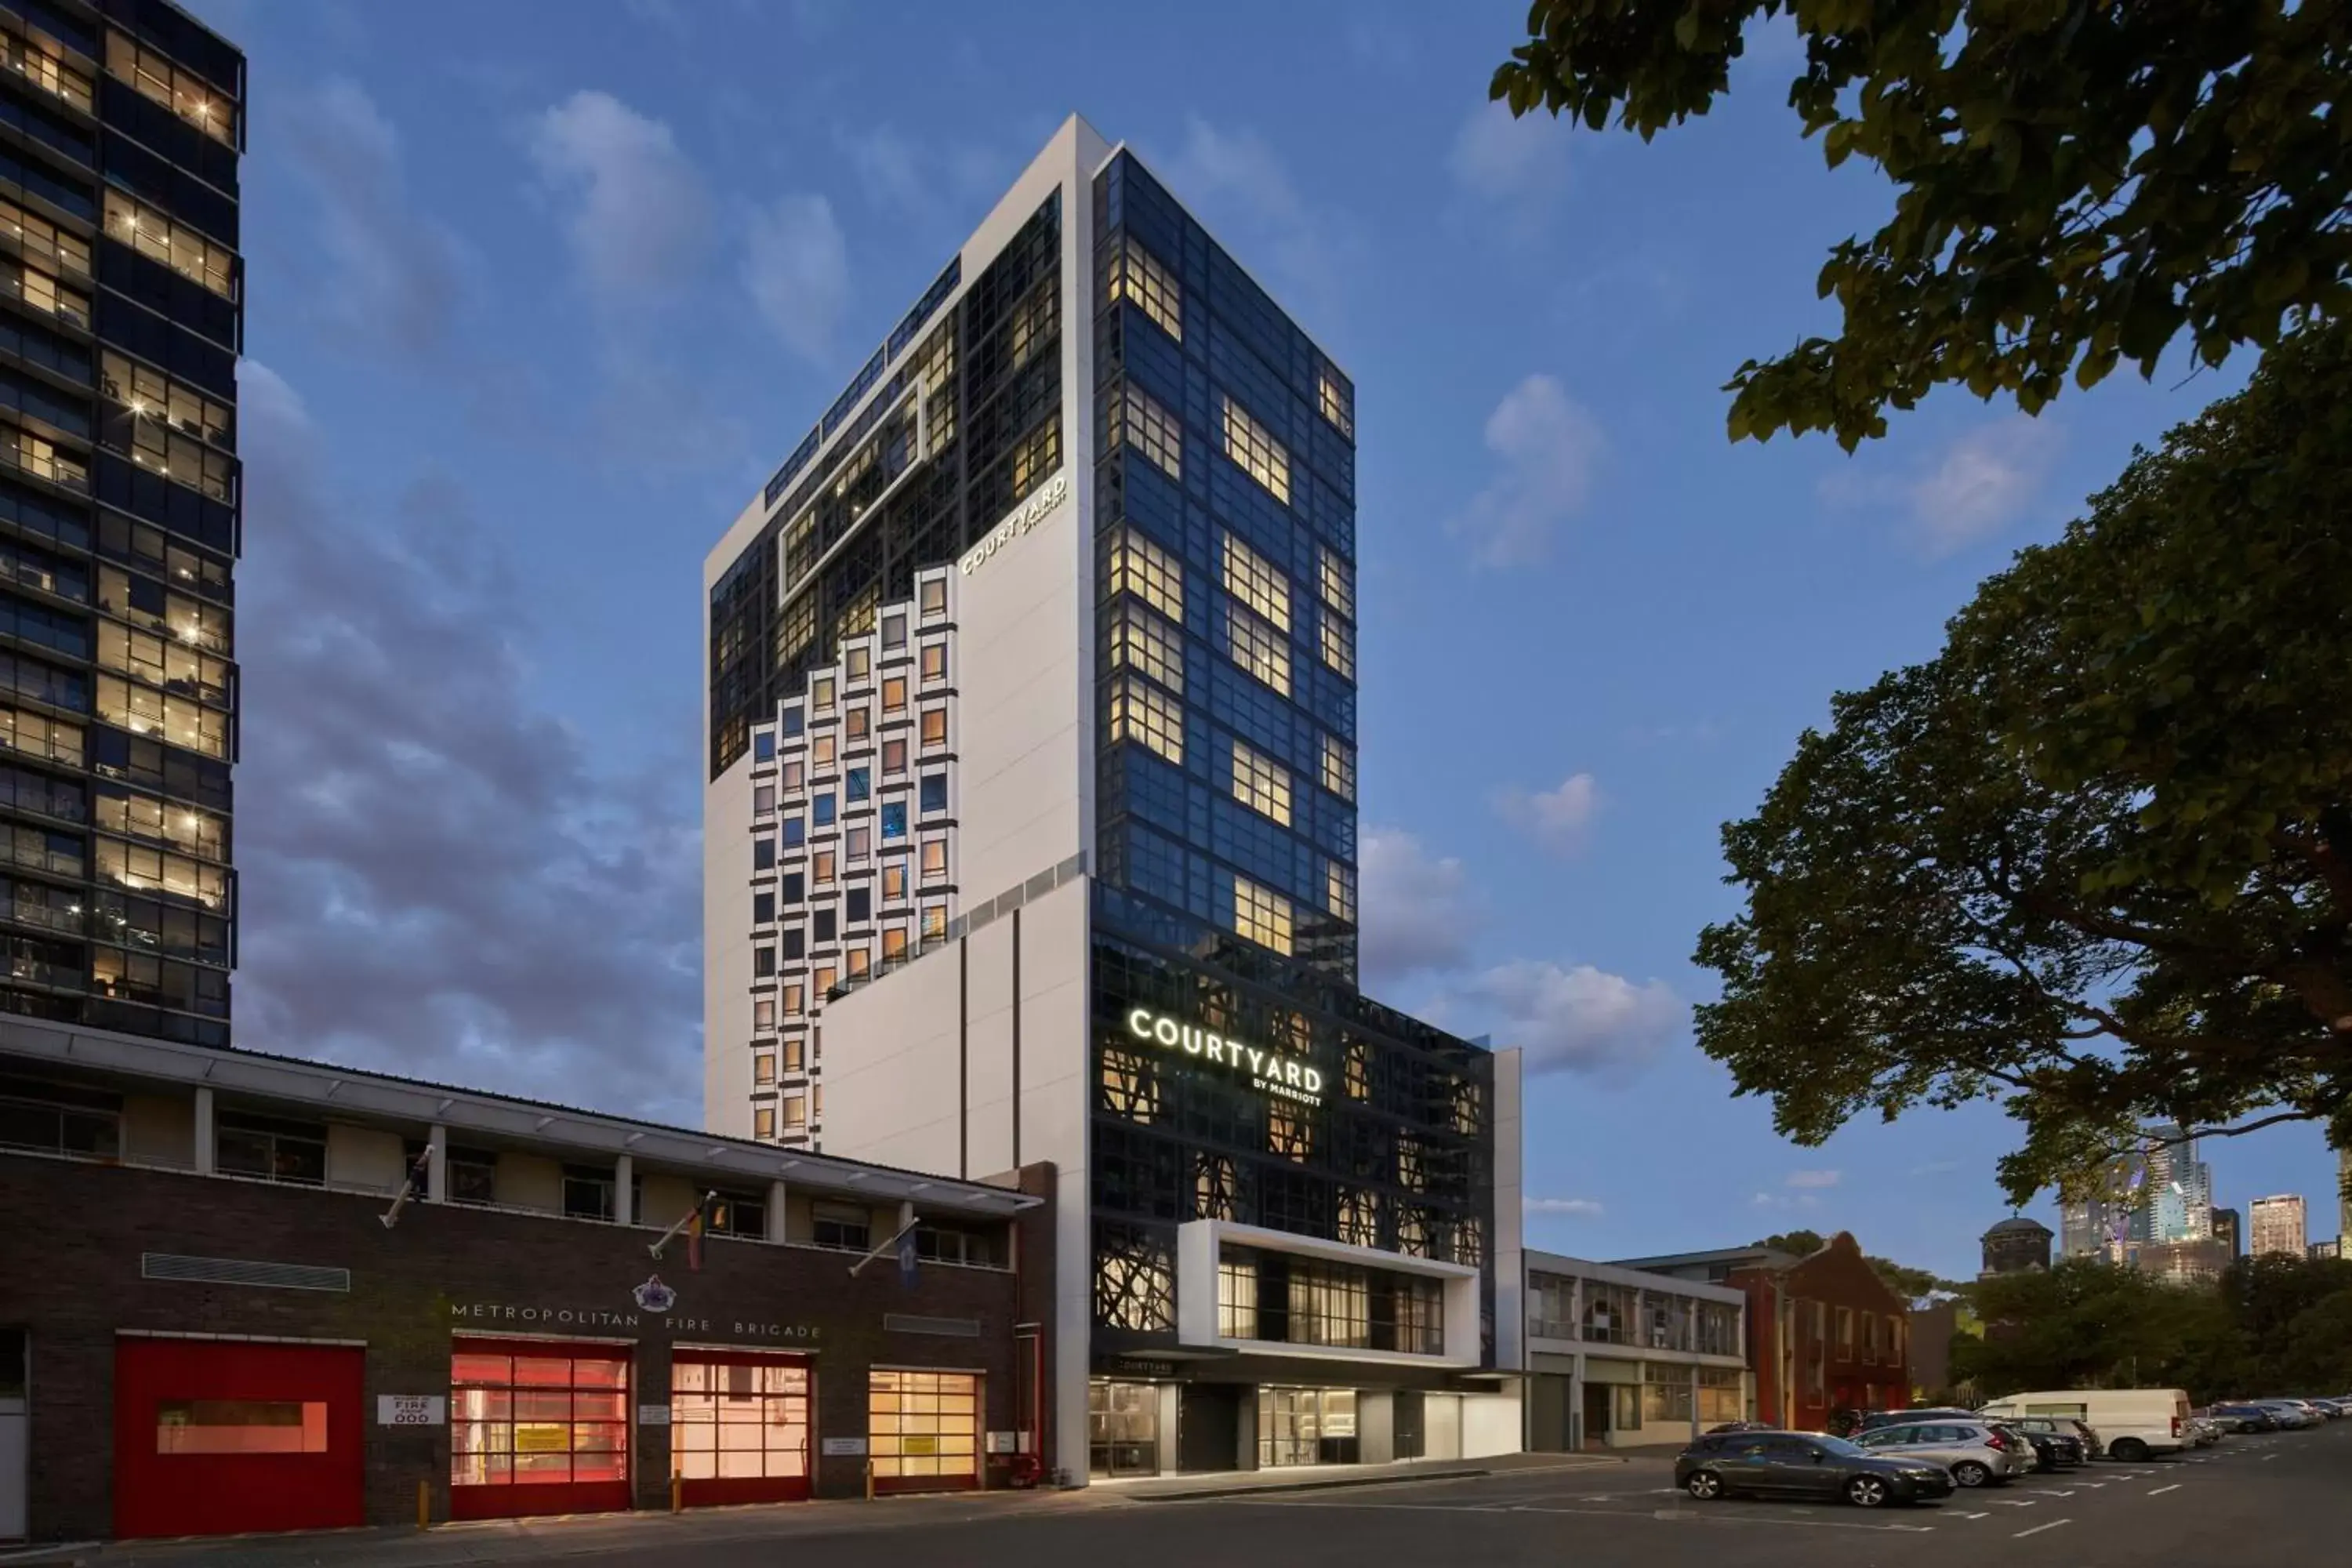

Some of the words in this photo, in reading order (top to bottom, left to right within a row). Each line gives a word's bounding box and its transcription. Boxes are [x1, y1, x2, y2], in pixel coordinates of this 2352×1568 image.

[962, 477, 1065, 575] COURTYARD
[1130, 1009, 1323, 1092] COURTYARD
[1254, 1078, 1266, 1090] BY
[1269, 1083, 1321, 1106] MARRIOTT
[452, 1304, 638, 1327] METROPOLITAN
[666, 1318, 710, 1331] FIRE
[735, 1322, 821, 1338] BRIGADE
